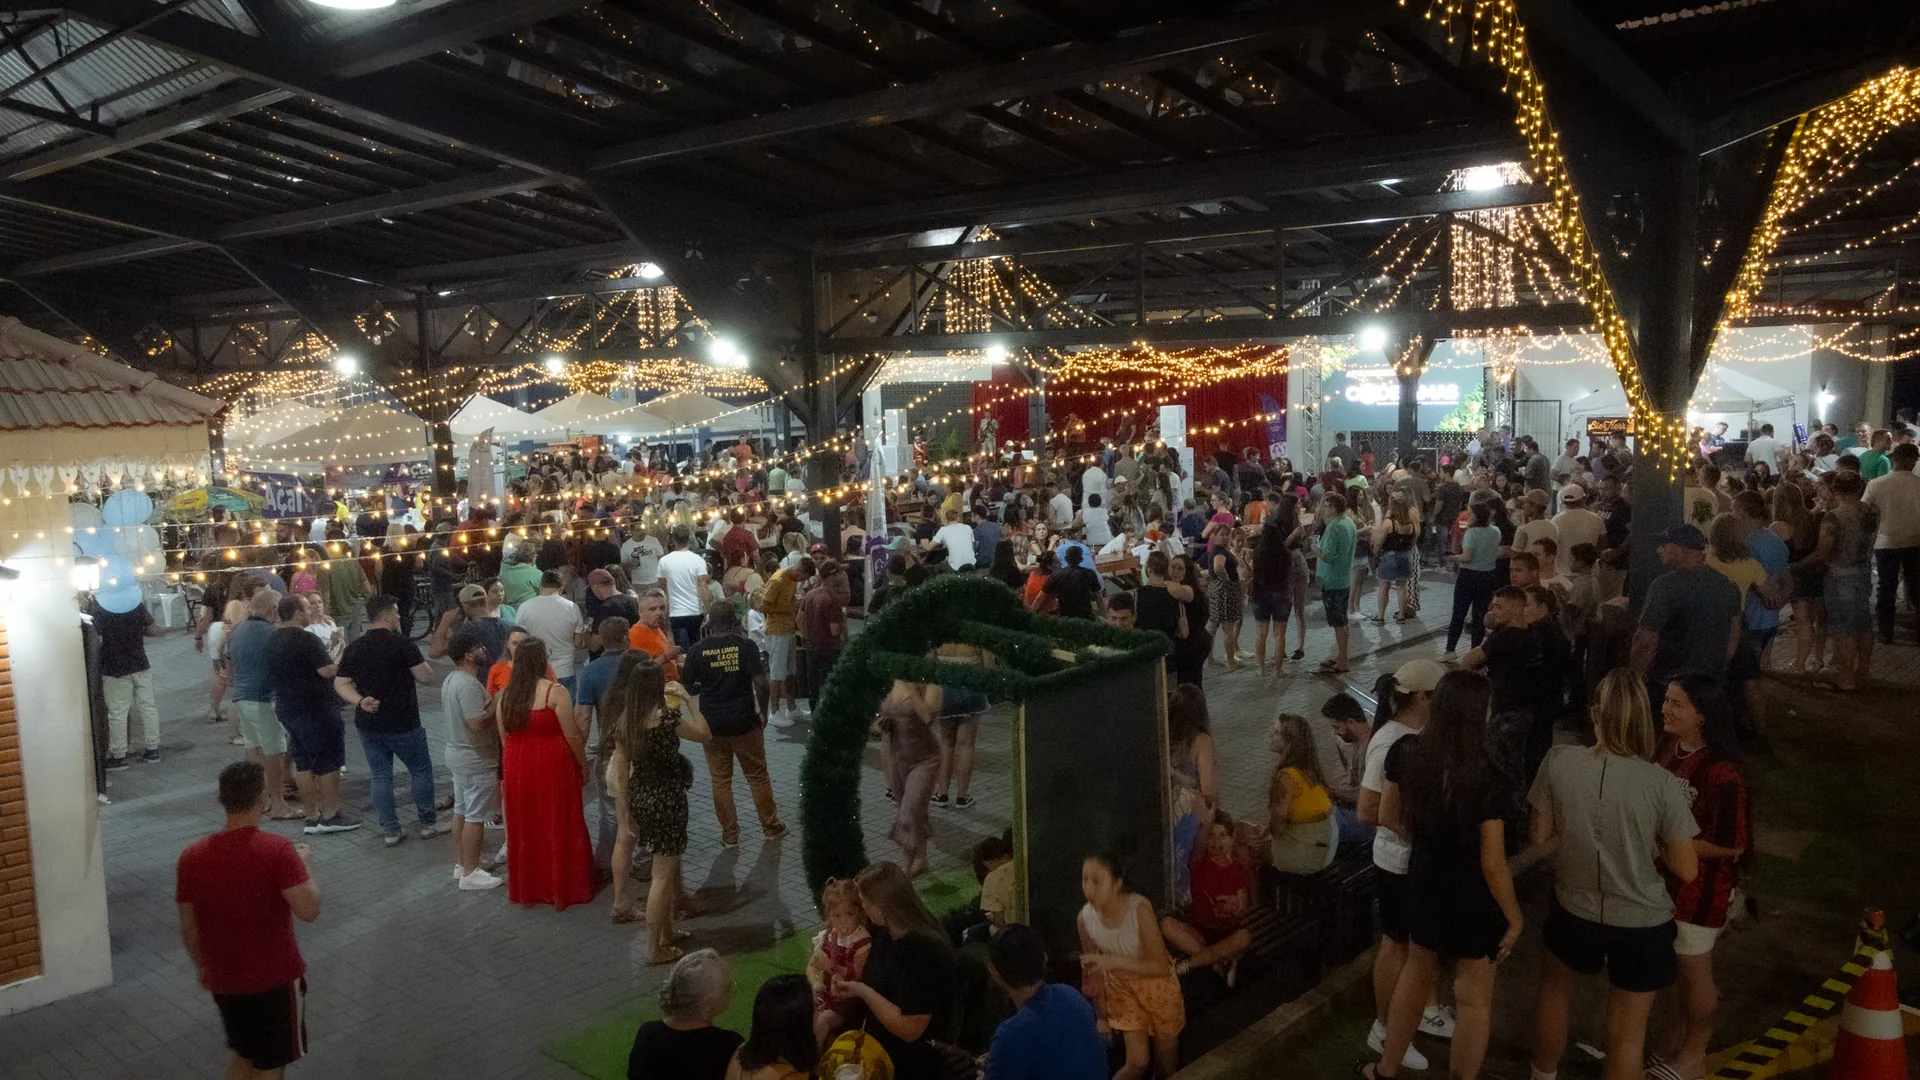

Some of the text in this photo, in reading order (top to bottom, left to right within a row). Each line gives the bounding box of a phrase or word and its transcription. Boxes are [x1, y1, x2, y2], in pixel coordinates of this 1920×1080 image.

[397, 463, 430, 479] Aça
[702, 646, 739, 657] PRAIA LIMPA
[726, 652, 739, 660] QUE
[710, 659, 731, 668] MENOS
